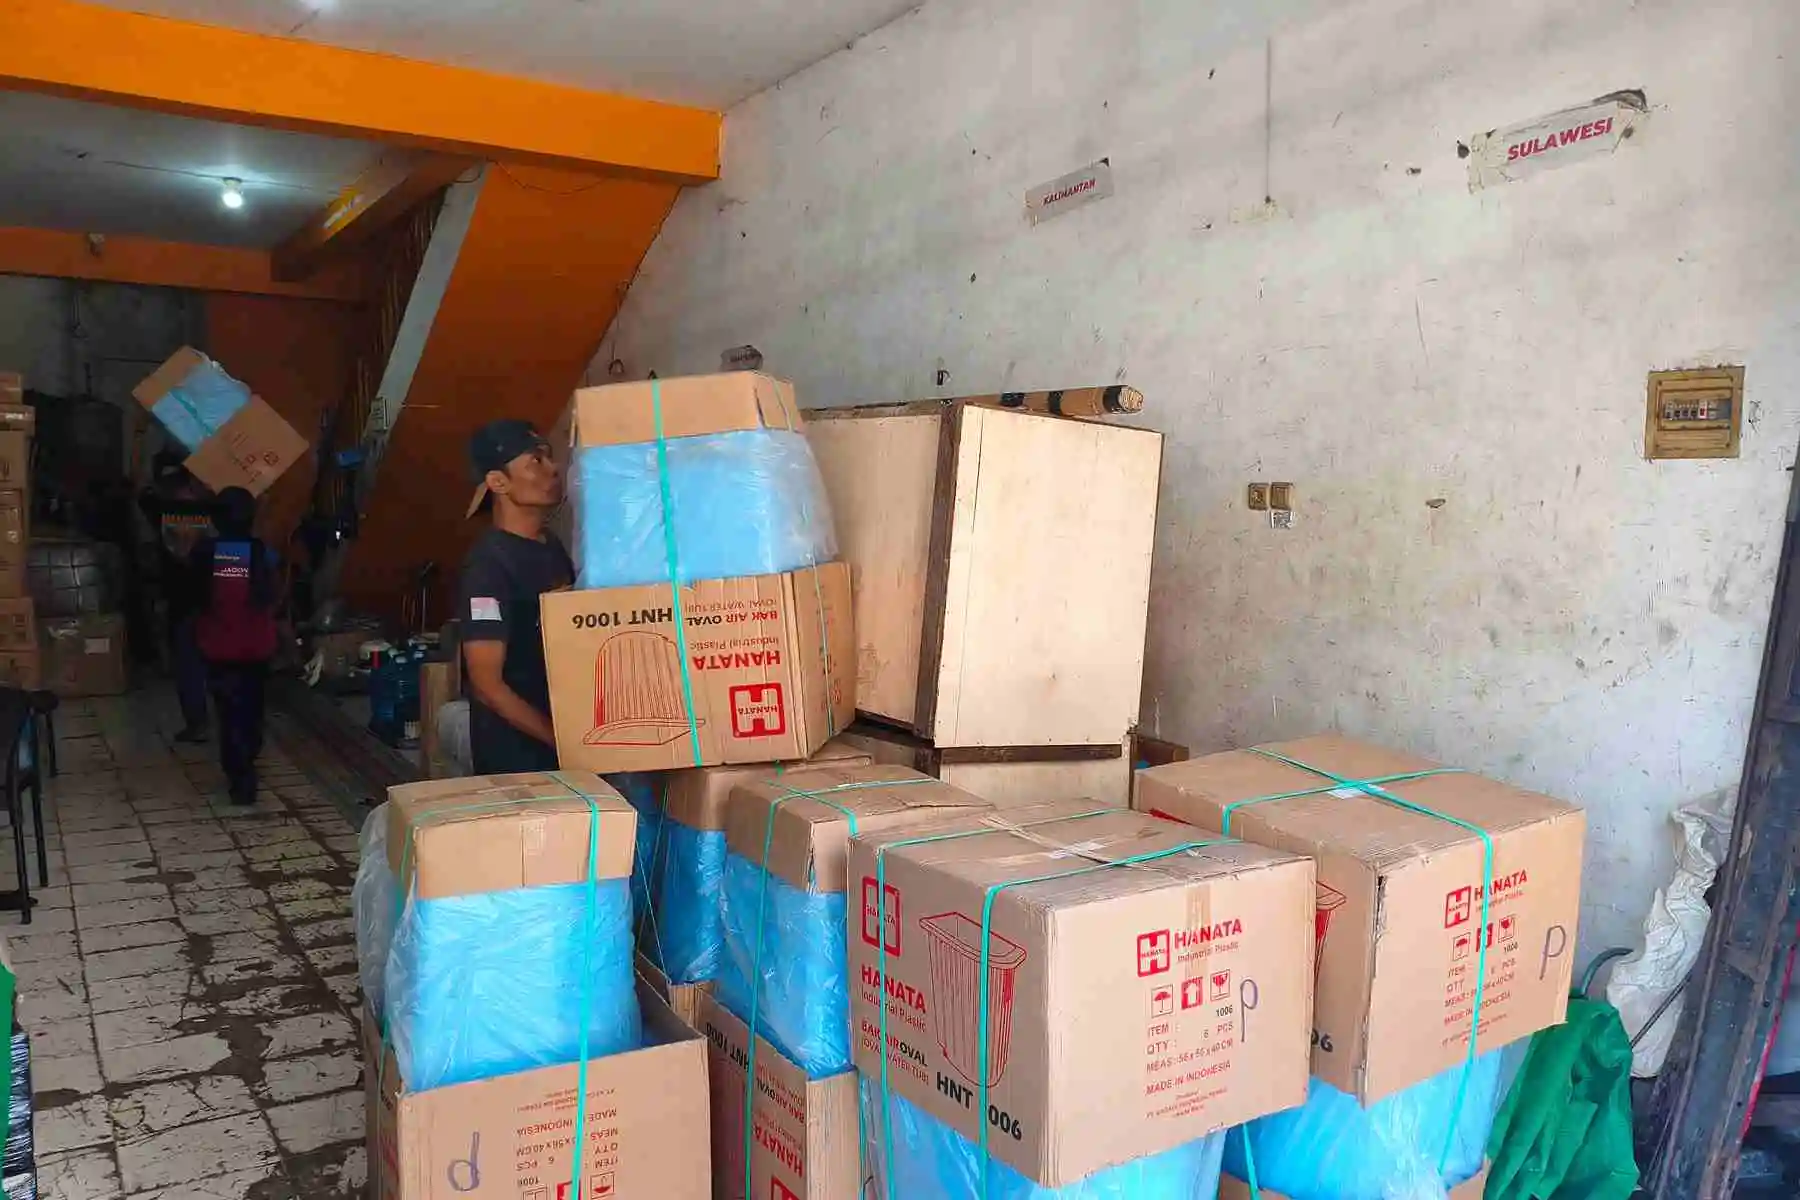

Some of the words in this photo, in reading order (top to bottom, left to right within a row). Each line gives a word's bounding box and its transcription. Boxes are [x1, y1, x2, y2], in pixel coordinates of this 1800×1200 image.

[1507, 116, 1613, 163] SULAWESI
[571, 611, 622, 629] 1006
[628, 607, 673, 626] HNT
[685, 615, 722, 627] OVAL
[724, 613, 748, 624] AIR
[751, 610, 778, 622] BAK
[689, 640, 726, 653] Plastic
[729, 637, 779, 650] Industrial
[692, 650, 781, 671] HANATA
[737, 704, 778, 715] HANATA
[1174, 918, 1243, 950] HANATA
[861, 963, 926, 1014] HANATA
[1215, 1004, 1234, 1017] 1006
[1147, 1022, 1170, 1039] ITEM
[1216, 1021, 1234, 1036] PCS
[899, 1041, 929, 1067] OVAL
[1146, 1041, 1169, 1056] QTY
[1145, 1079, 1173, 1098] MADE
[1174, 1075, 1184, 1088] IN
[1185, 1060, 1231, 1083] INDONESIA
[936, 1071, 974, 1110] HNT
[987, 1102, 1023, 1142] 006
[587, 1108, 617, 1124] MADE
[516, 1118, 573, 1137] INDONESIA
[594, 1143, 619, 1155] QTY
[753, 1124, 803, 1178] HANATA
[515, 1159, 538, 1172] PCS
[594, 1155, 619, 1169] ITEM
